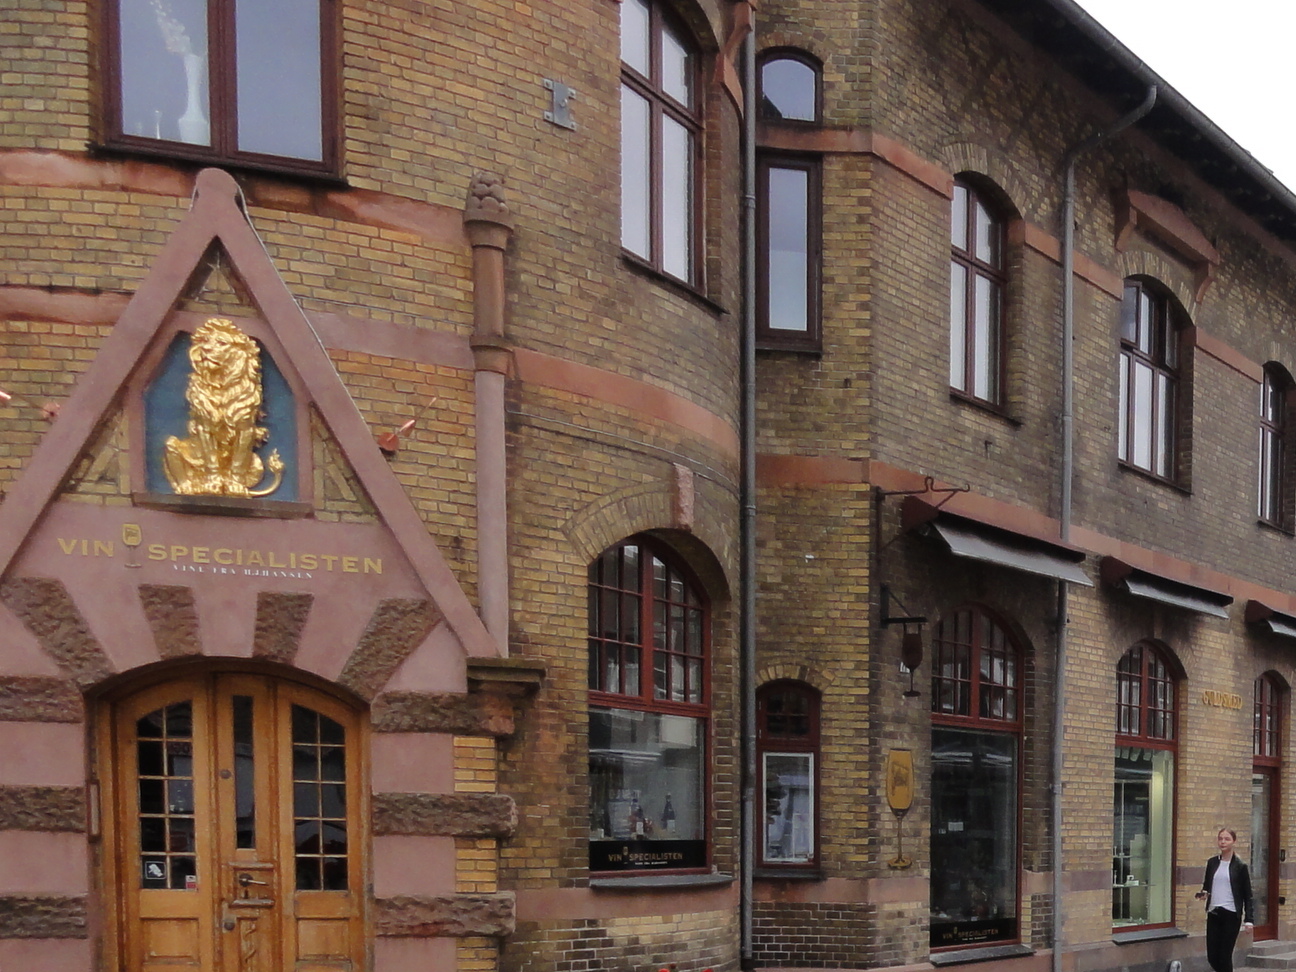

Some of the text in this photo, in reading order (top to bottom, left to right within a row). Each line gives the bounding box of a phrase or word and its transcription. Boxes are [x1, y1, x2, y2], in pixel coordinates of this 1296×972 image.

[57, 538, 384, 575] VIN SPECIALISTEN
[629, 853, 683, 861] SPECIALISTEN
